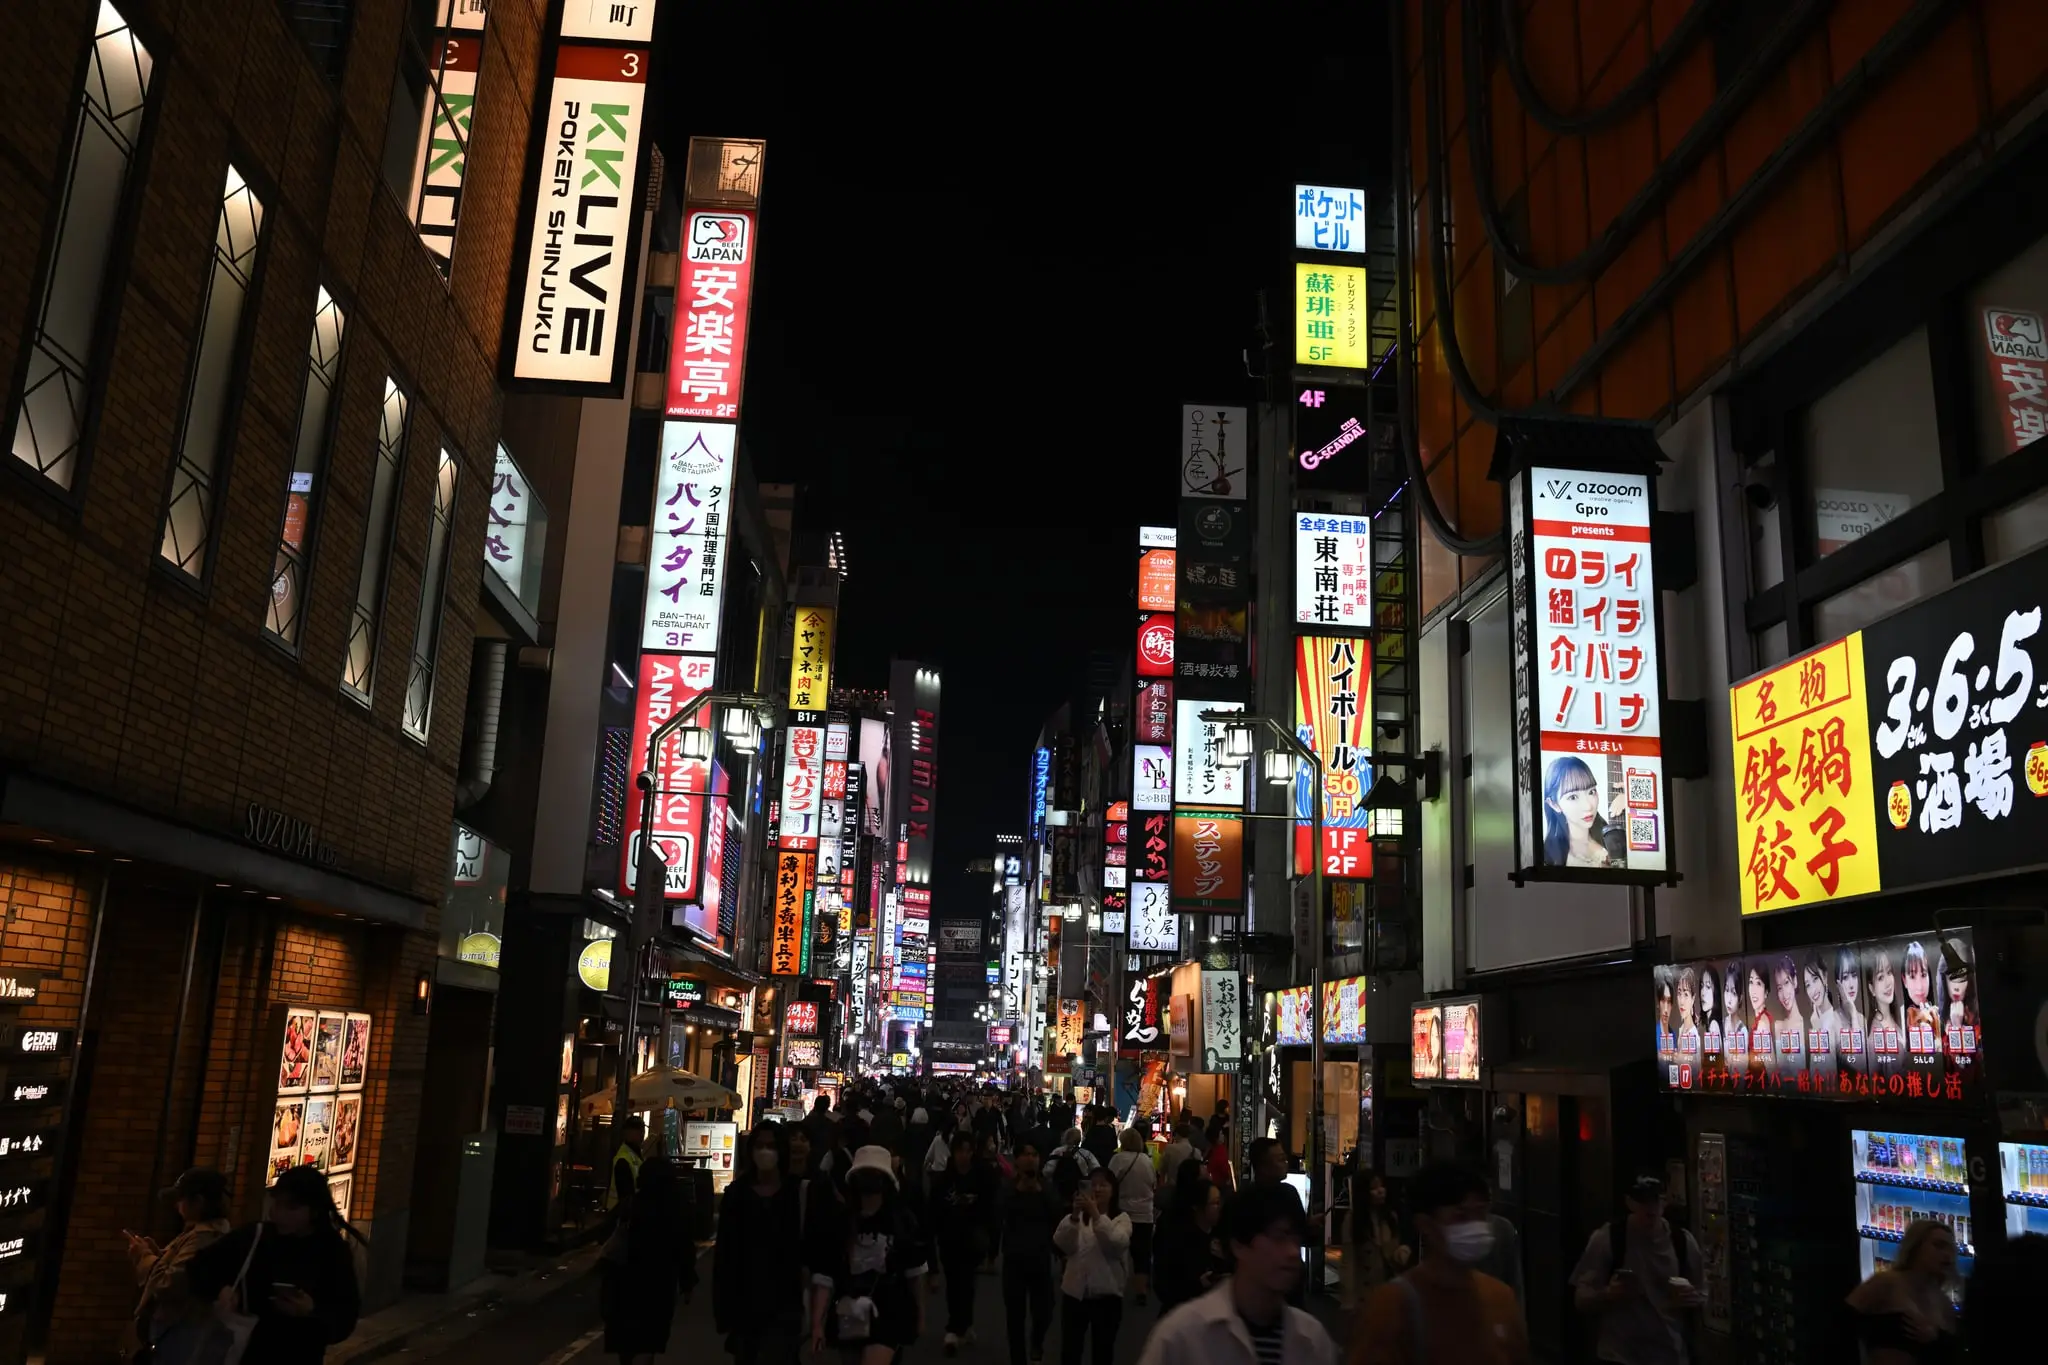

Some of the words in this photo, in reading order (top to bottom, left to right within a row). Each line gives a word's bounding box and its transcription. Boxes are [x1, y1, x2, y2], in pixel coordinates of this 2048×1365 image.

[621, 53, 639, 77] 3
[553, 101, 580, 198] POKER
[1298, 188, 1362, 221] ポケット
[561, 103, 630, 356] KKLIVE
[1314, 221, 1349, 250] ビル
[691, 247, 744, 262] JAPAN
[532, 210, 565, 354] SHINJUKU
[1305, 273, 1335, 340] 蘇琲亜
[1347, 274, 1356, 348] エレガンス・ラウンジ
[680, 267, 738, 404] 安楽亭
[1309, 346, 1333, 360] 5F
[716, 403, 737, 417] 2F
[1299, 389, 1325, 408] 4F
[668, 406, 713, 417] ANRAKUTEI
[1299, 426, 1366, 470] G-SCANDAL
[672, 463, 721, 475] RESTAURANT
[678, 460, 715, 469] BAN-THAI
[1577, 482, 1642, 497] azooom
[1576, 502, 1608, 517] Gpro
[1299, 517, 1366, 534] 全卓全自動
[1572, 525, 1615, 536] presents
[660, 482, 701, 603] バンタイ
[700, 485, 722, 597] タイ国料理専門店
[1150, 558, 1174, 566] ZINO
[1356, 537, 1367, 606] リーチ麻雀
[1314, 536, 1339, 622] 東南荘
[1342, 564, 1354, 615] 専門店
[1141, 595, 1162, 603] 600
[652, 620, 711, 630] RESTAURANT
[659, 612, 705, 621] BAN-THAI
[1299, 610, 1311, 621] 3F
[666, 632, 693, 646] 3F
[1581, 550, 1610, 725] ライバー
[1614, 552, 1645, 729] イチナナ
[687, 663, 710, 677] 2F
[794, 630, 814, 706] ヤマネ肉店
[1180, 662, 1239, 678] 酒場牧場
[1138, 680, 1149, 688] 3F
[1755, 658, 1826, 724] 名物
[797, 712, 817, 723] B1F
[1151, 683, 1167, 739] 龍幻酒家
[1330, 642, 1356, 771] ハイボール
[1968, 700, 1991, 729] ろく
[1576, 739, 1623, 752] まいまい
[1908, 722, 1927, 749] さん
[1741, 716, 1852, 823] 鉄鍋
[1916, 728, 2014, 833] 酒場
[1891, 792, 1908, 823] 365
[244, 803, 313, 858] SUZUYA
[1329, 831, 1357, 849] 1F
[788, 838, 807, 849] 4F
[1193, 820, 1224, 897] ステップ
[1327, 856, 1357, 875] 2F
[1746, 805, 1858, 909] 餃子
[1142, 886, 1159, 949] うまいもん
[668, 991, 701, 1001] Pizzeria
[896, 1006, 924, 1018] SAUNA
[33, 1032, 58, 1046] EDEN
[1223, 1062, 1240, 1071] B1F
[1839, 1070, 1962, 1100] あなたの推し活
